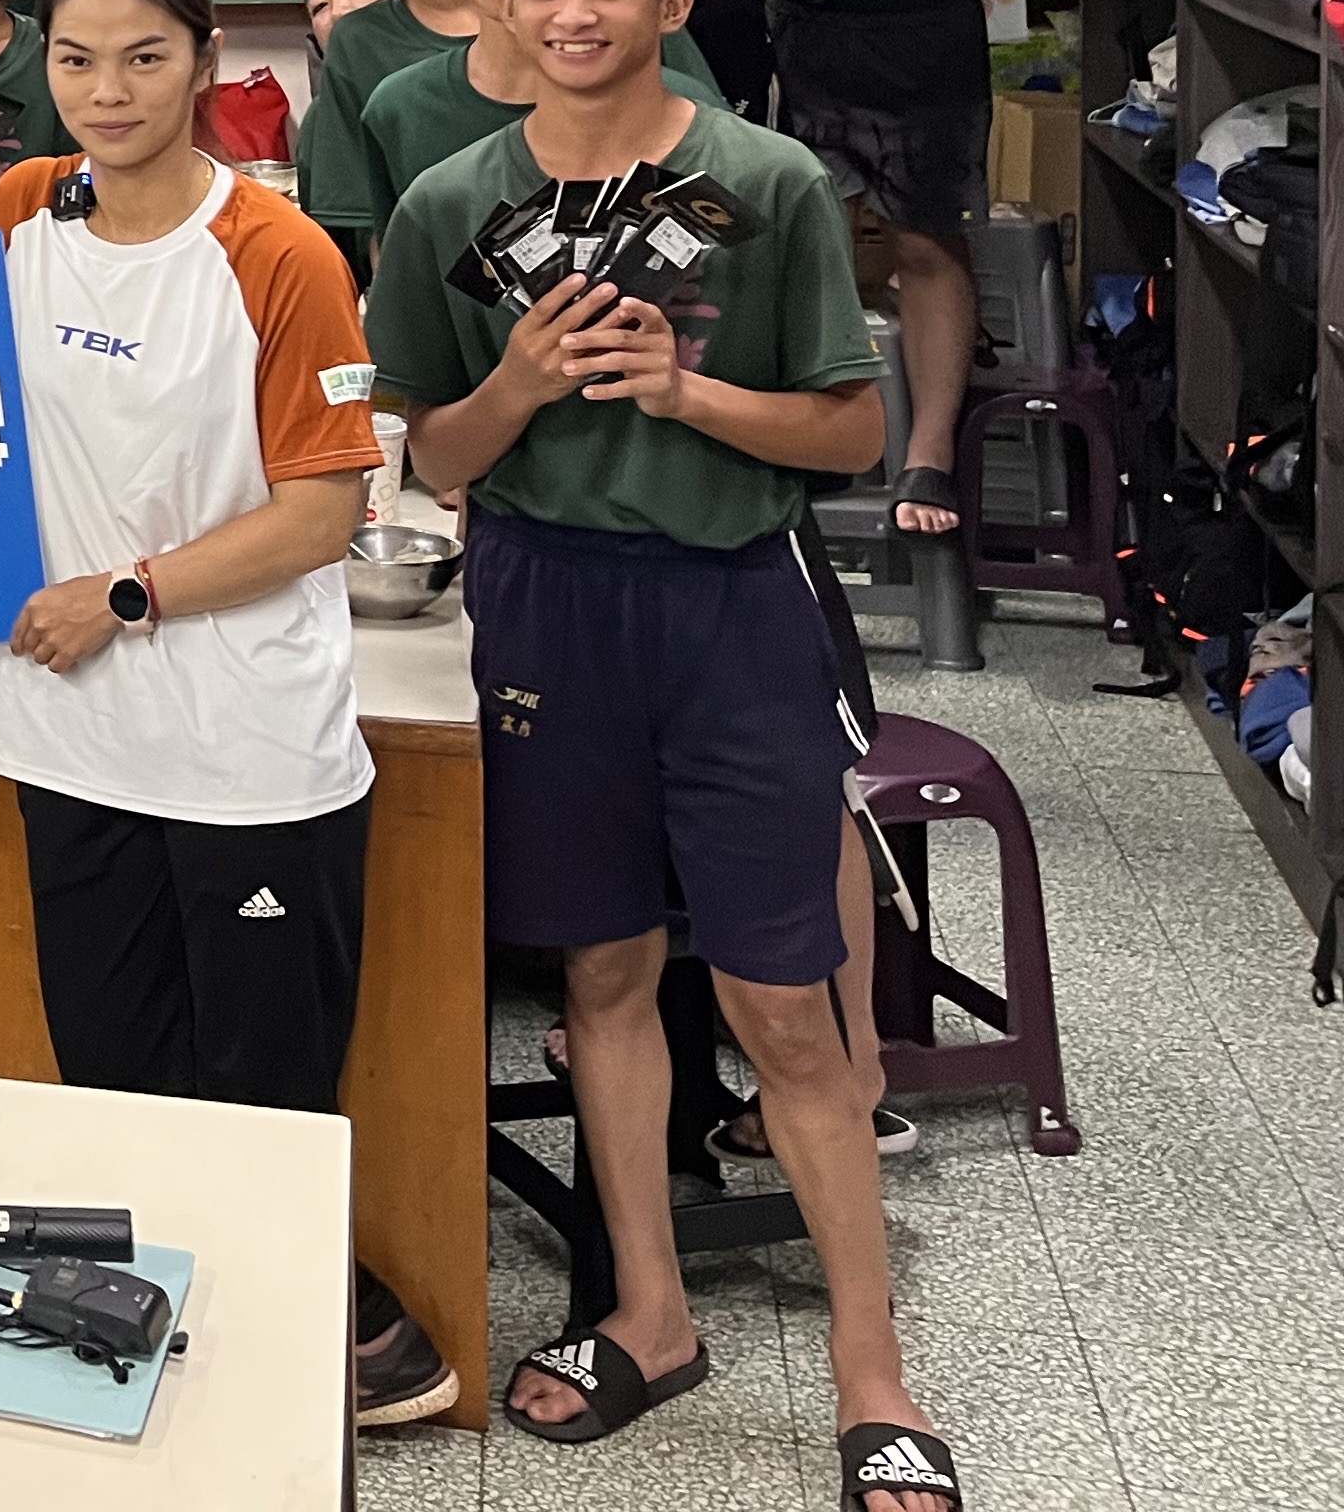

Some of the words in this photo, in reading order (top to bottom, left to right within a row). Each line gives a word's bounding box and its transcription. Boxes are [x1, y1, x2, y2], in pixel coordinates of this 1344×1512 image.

[55, 323, 144, 362] TBK
[238, 905, 286, 918] adidas
[529, 1348, 599, 1391] adidas
[857, 1461, 956, 1488] adidas
